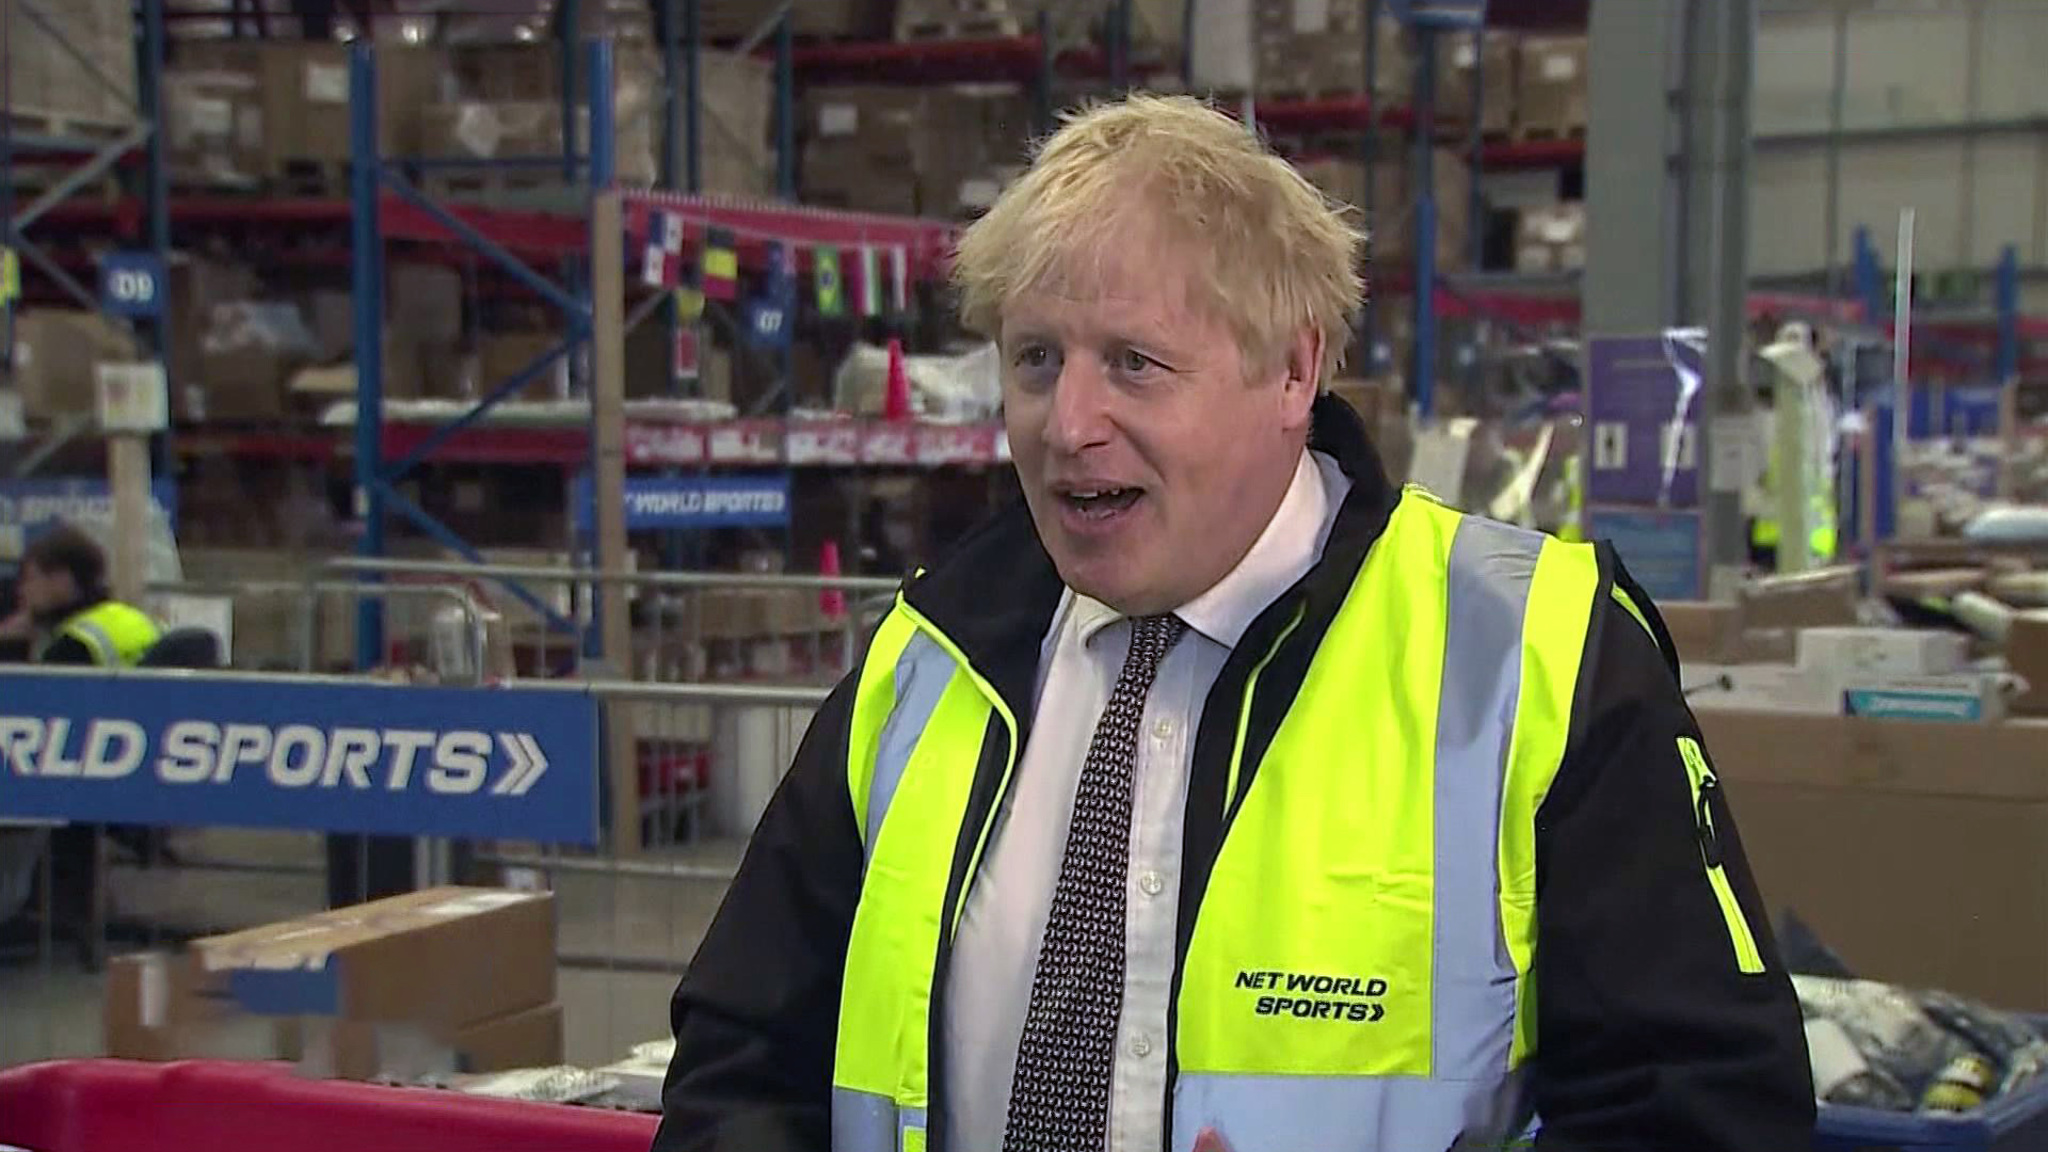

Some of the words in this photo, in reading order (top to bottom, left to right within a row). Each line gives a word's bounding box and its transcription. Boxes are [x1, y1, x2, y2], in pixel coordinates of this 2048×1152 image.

[636, 493, 701, 513] WORLD
[157, 720, 494, 793] SPORTS
[1235, 971, 1284, 989] NET
[1286, 974, 1387, 996] WORLD
[1256, 996, 1368, 1021] SPORTS
